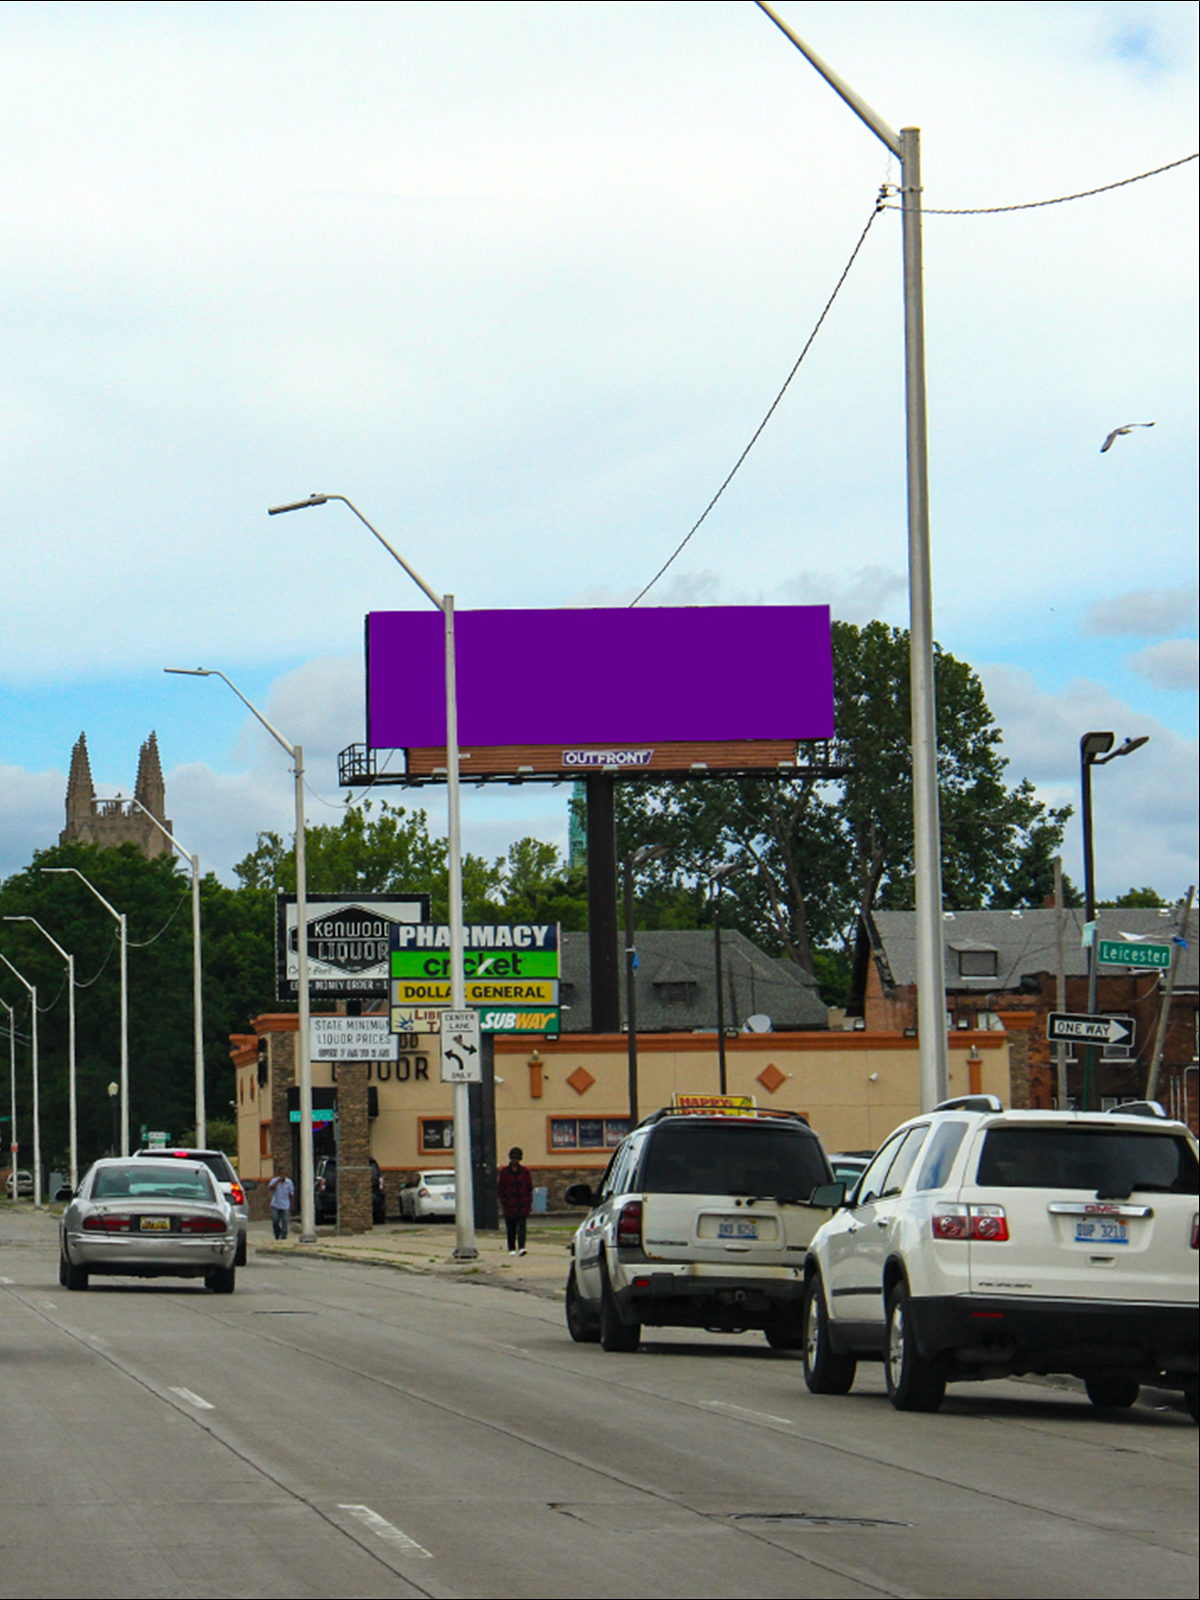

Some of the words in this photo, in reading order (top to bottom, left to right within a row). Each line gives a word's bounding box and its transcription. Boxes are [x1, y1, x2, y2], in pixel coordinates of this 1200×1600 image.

[565, 752, 647, 764] OUTFRONT
[318, 941, 389, 963] LIQUOR
[1103, 945, 1167, 964] Leicester
[423, 953, 522, 976] crcket
[404, 986, 467, 998] DOLLA
[472, 986, 545, 998] GENERAL
[315, 1020, 343, 1031] STATE
[481, 1011, 556, 1030] SUBWAY
[1057, 1021, 1082, 1034] ONE
[1085, 1024, 1110, 1036] WAY
[317, 1033, 353, 1045] LIQUOR
[356, 1033, 391, 1045] PRICES
[332, 1057, 429, 1082] LUOR
[1084, 1205, 1120, 1214] GMC
